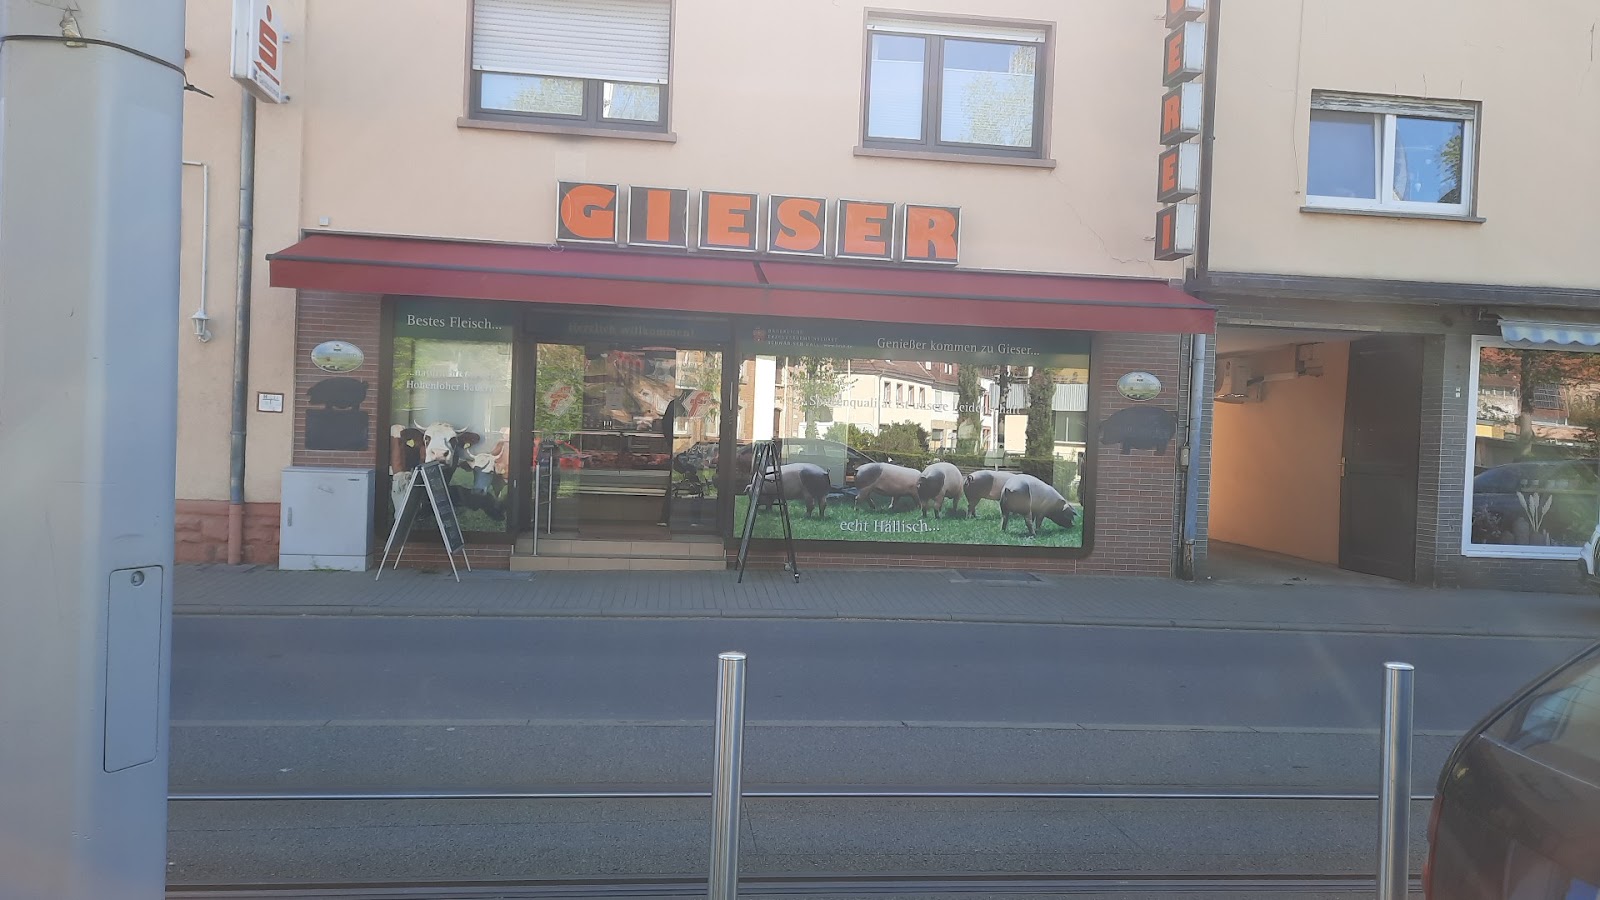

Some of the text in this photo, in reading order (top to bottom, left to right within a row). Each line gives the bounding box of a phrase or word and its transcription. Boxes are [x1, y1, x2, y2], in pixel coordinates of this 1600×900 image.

[560, 185, 957, 259] GIESER
[407, 314, 502, 330] Bestes Fleisch...
[877, 337, 1040, 356] Genießer kommen zu Gieser...
[839, 519, 940, 533] echt Hällisch...
